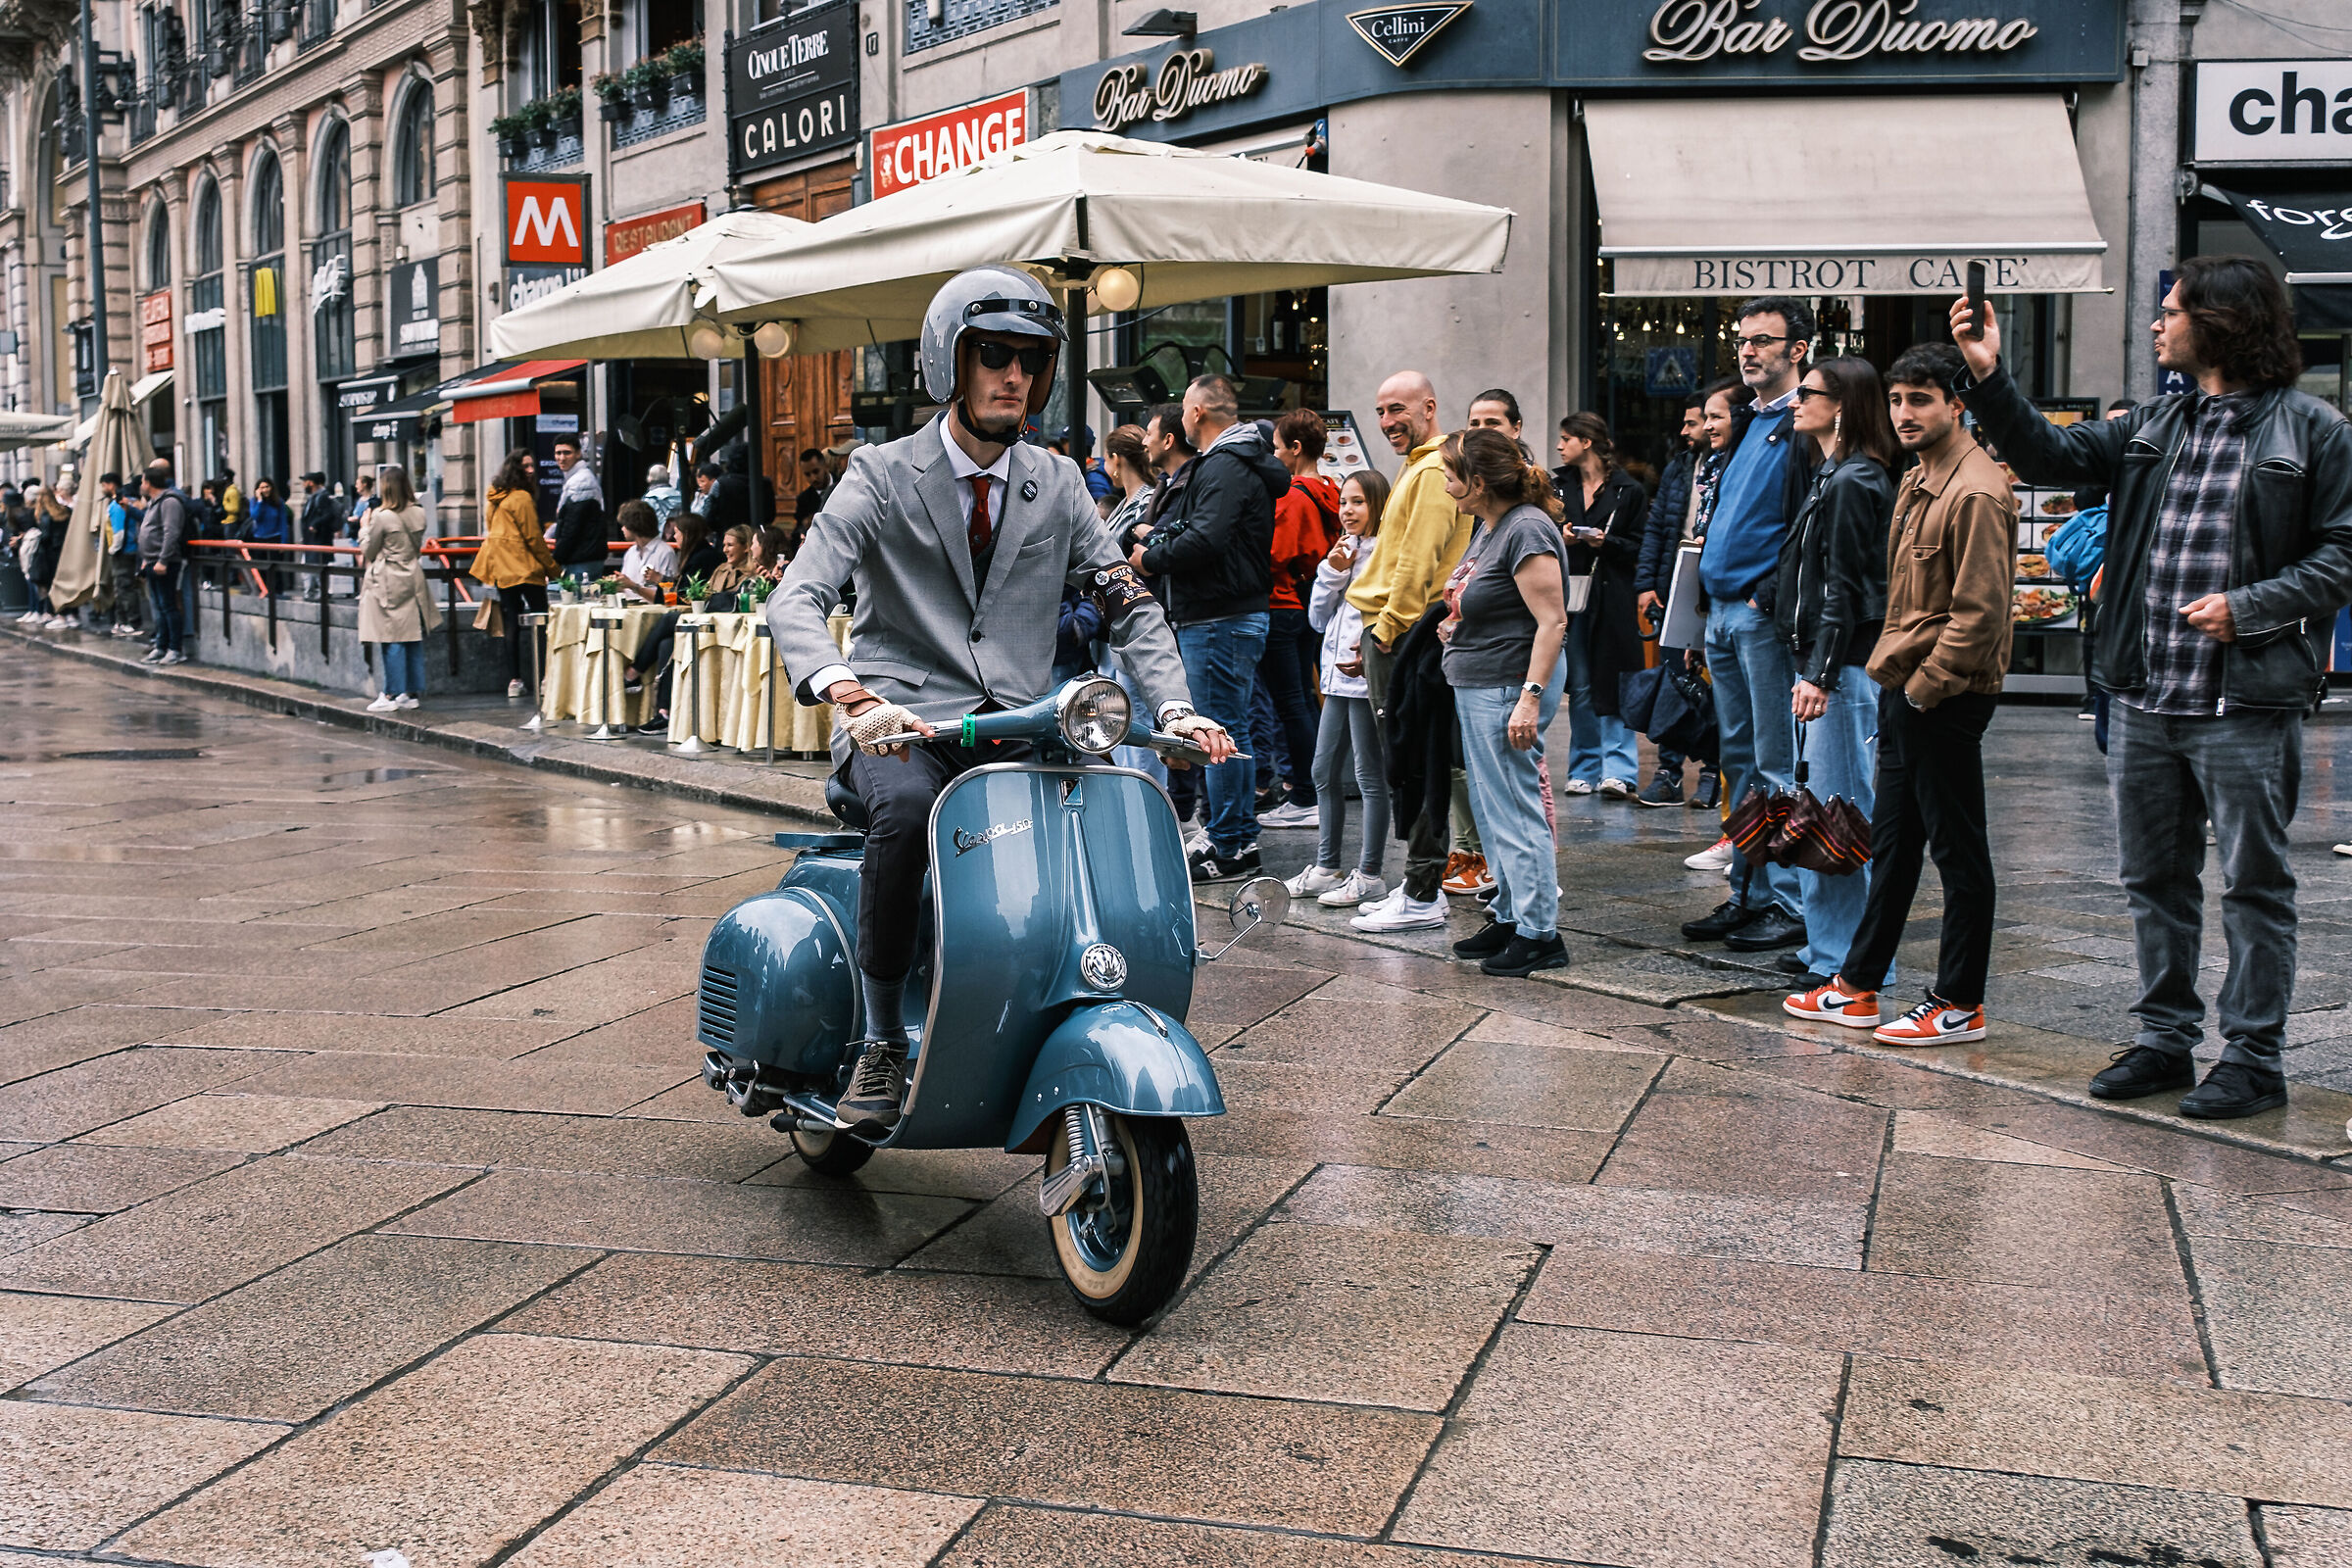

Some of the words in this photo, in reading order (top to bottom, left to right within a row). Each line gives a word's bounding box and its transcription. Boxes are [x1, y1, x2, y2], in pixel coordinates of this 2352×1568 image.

[1372, 17, 1425, 38] Cellini
[1642, 0, 1794, 62] Bar
[1796, 0, 2038, 62] Duomo
[1091, 63, 1154, 132] Bar
[1152, 48, 1265, 122] Duomo
[745, 94, 846, 159] CALORI
[894, 107, 1022, 184] CHANGE
[513, 195, 579, 247] M
[614, 215, 693, 254] RESTAURANT
[1693, 259, 1876, 289] BISTROT
[1909, 258, 2028, 289] CAE'
